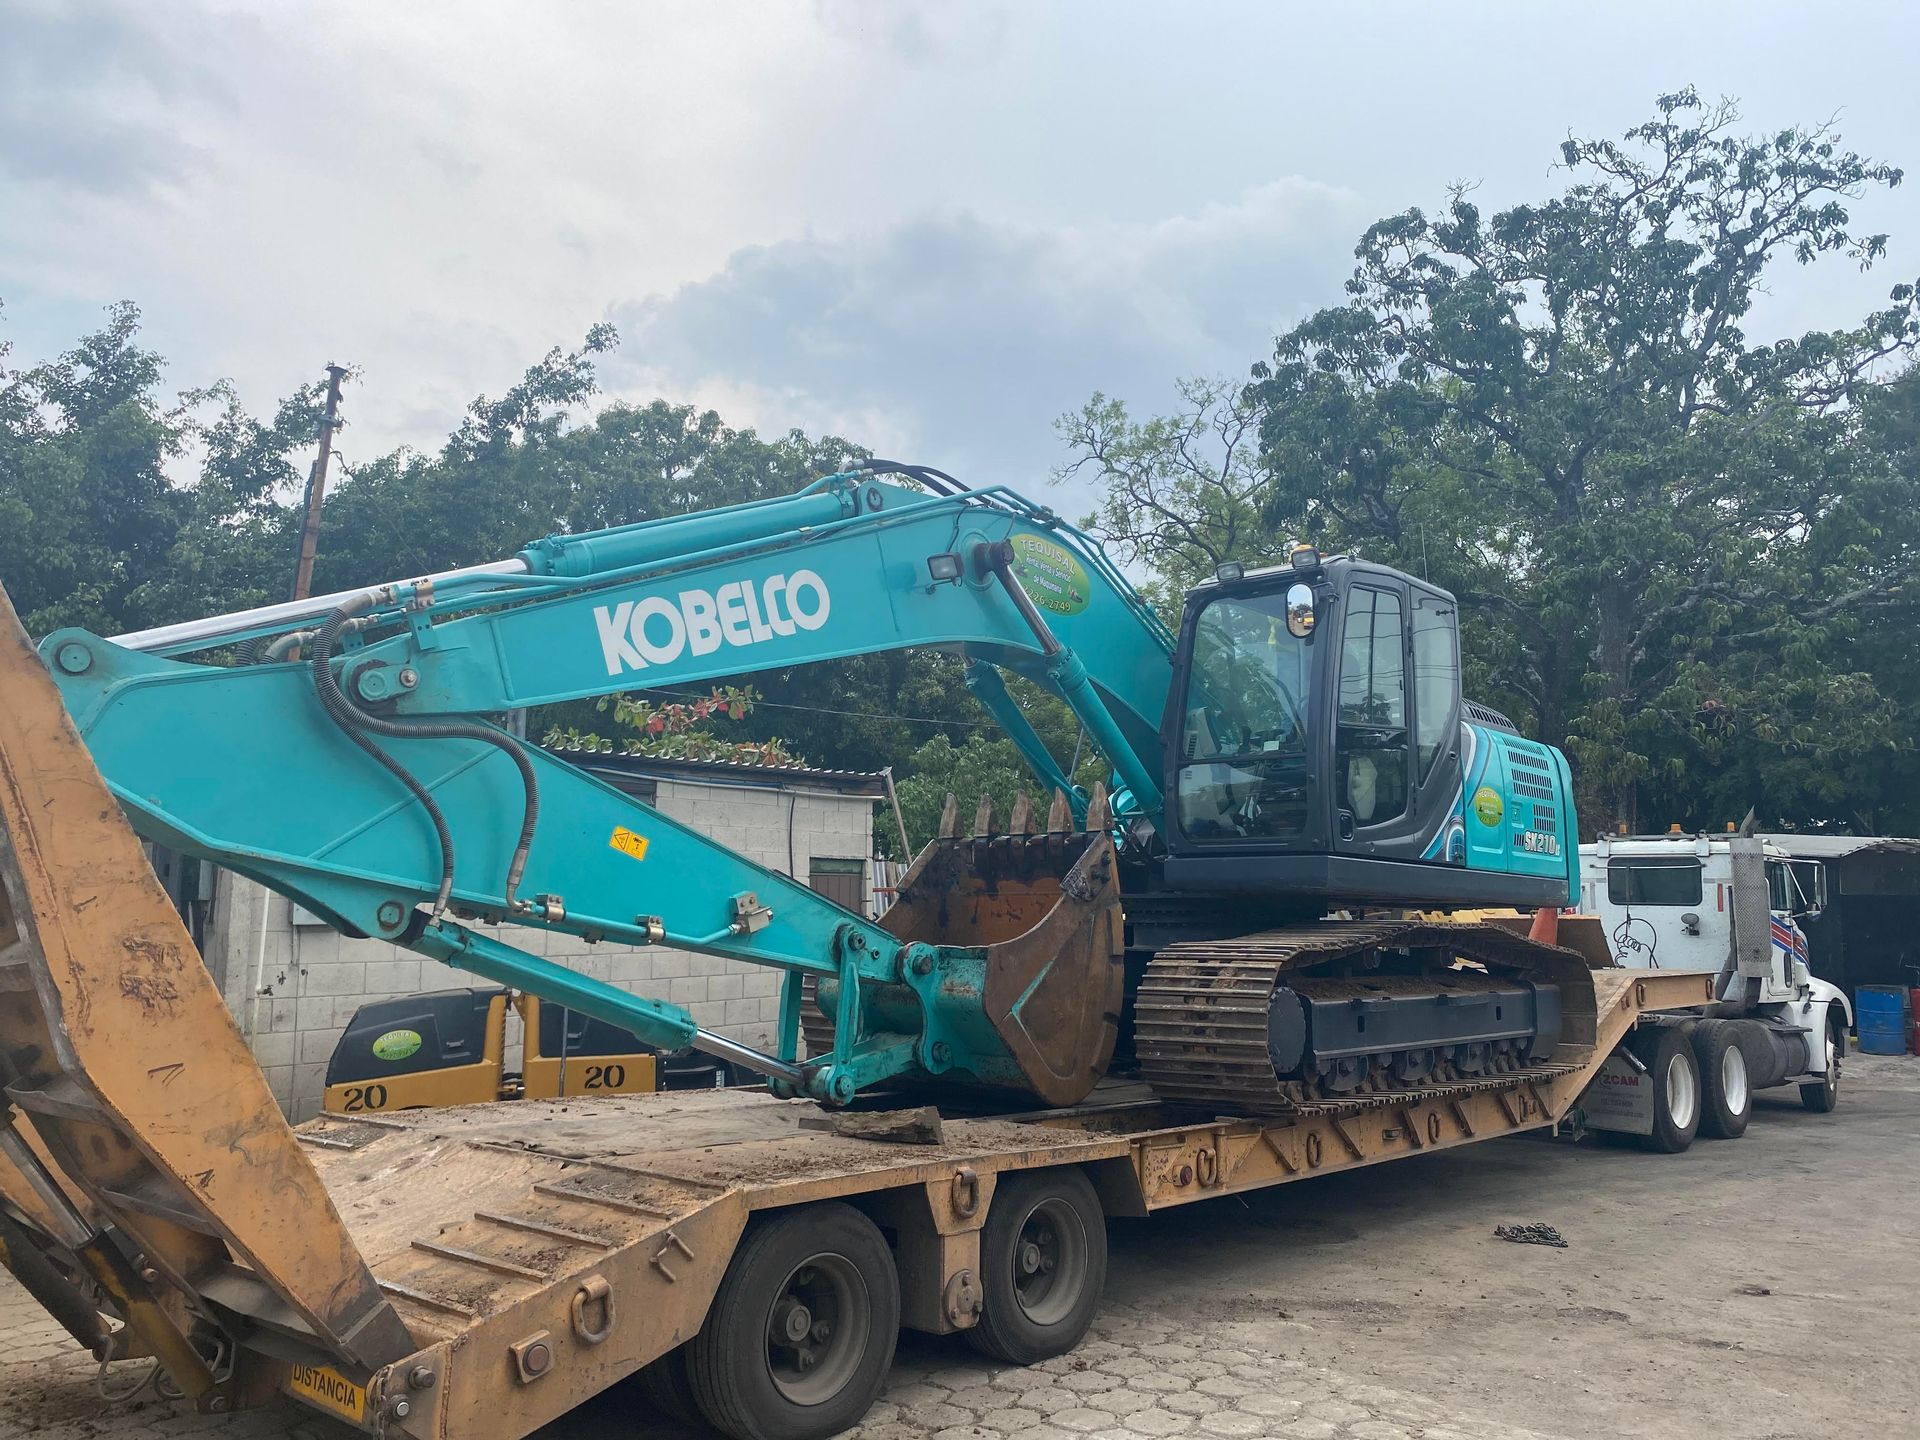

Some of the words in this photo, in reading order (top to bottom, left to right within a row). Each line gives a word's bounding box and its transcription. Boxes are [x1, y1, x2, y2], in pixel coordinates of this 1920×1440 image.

[1021, 540, 1075, 575] TEQUISAL
[593, 569, 831, 676] KOBELCO
[1525, 831, 1556, 855] SK210
[585, 1065, 625, 1088] 20
[344, 1085, 387, 1112] 20
[294, 1363, 356, 1410] DISTANCIA
